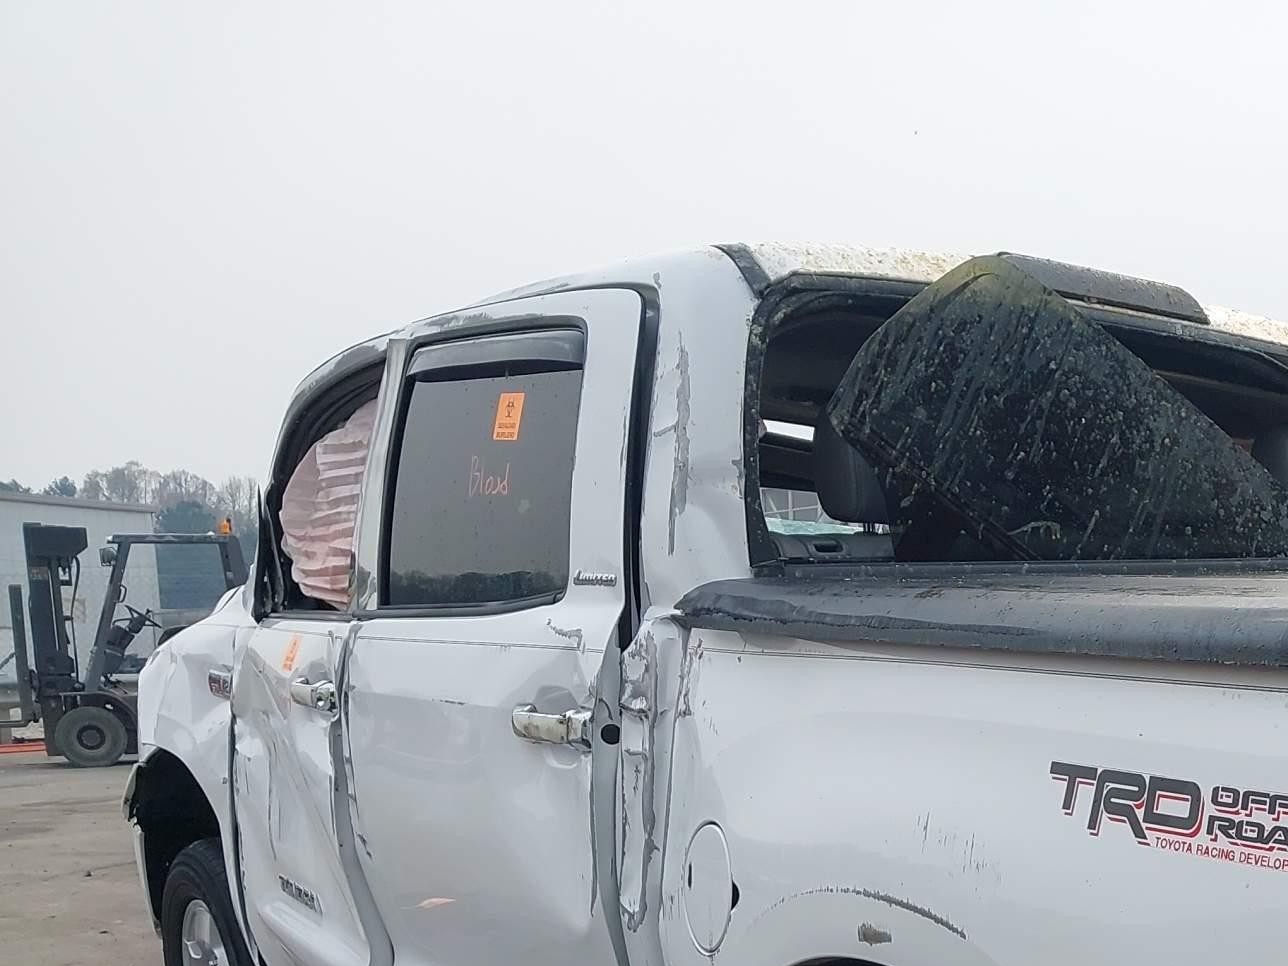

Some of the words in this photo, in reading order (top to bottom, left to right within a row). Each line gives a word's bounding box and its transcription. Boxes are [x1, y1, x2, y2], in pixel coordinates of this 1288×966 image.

[1049, 760, 1204, 846] TRD
[1154, 836, 1194, 855] TOYOTA
[1196, 843, 1236, 862] RACING
